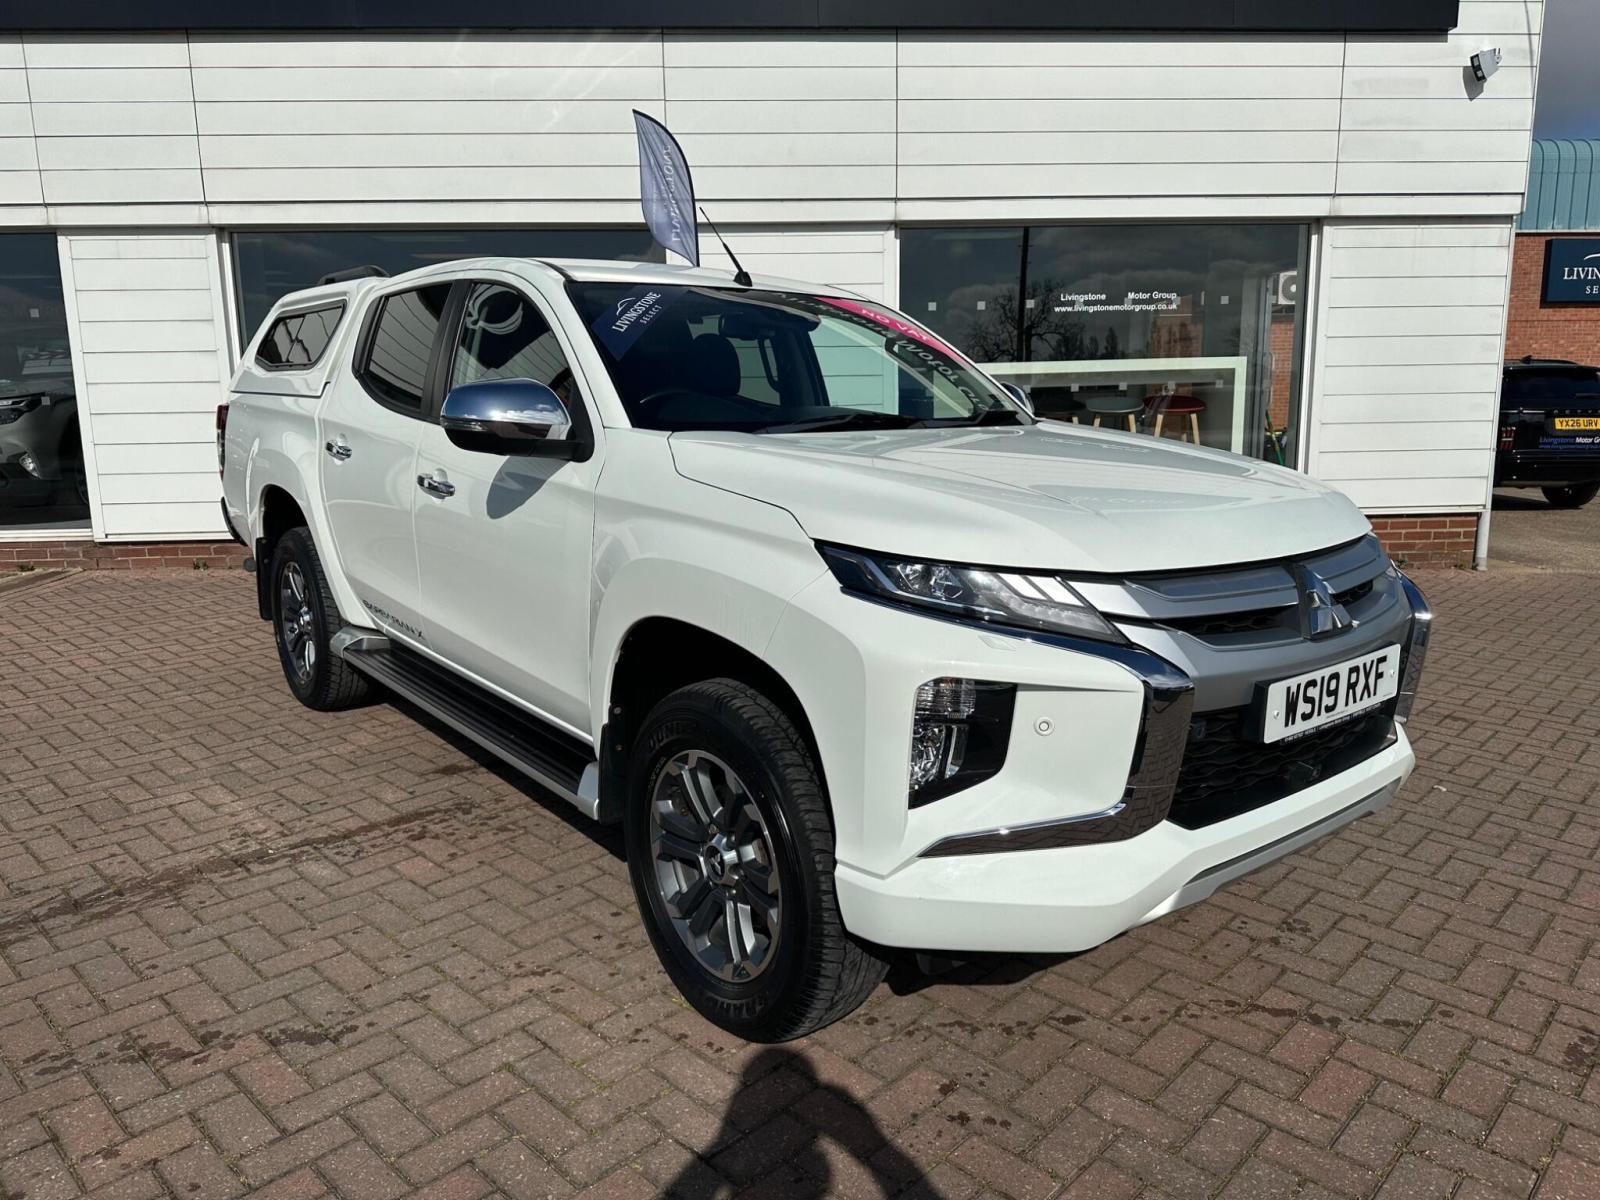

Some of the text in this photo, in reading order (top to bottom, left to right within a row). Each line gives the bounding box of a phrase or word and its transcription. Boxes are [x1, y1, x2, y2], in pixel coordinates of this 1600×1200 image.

[1060, 291, 1177, 302] Livingstone Motor Group
[612, 291, 662, 332] LIVINGSTONE
[639, 304, 662, 324] SELECT
[1054, 303, 1178, 313] www.livingstonemotorgroup.co.uk
[861, 308, 930, 342] NO VAT
[1559, 419, 1598, 427] YX26 URV
[1284, 672, 1340, 728] WS19
[1344, 655, 1388, 707] RXF
